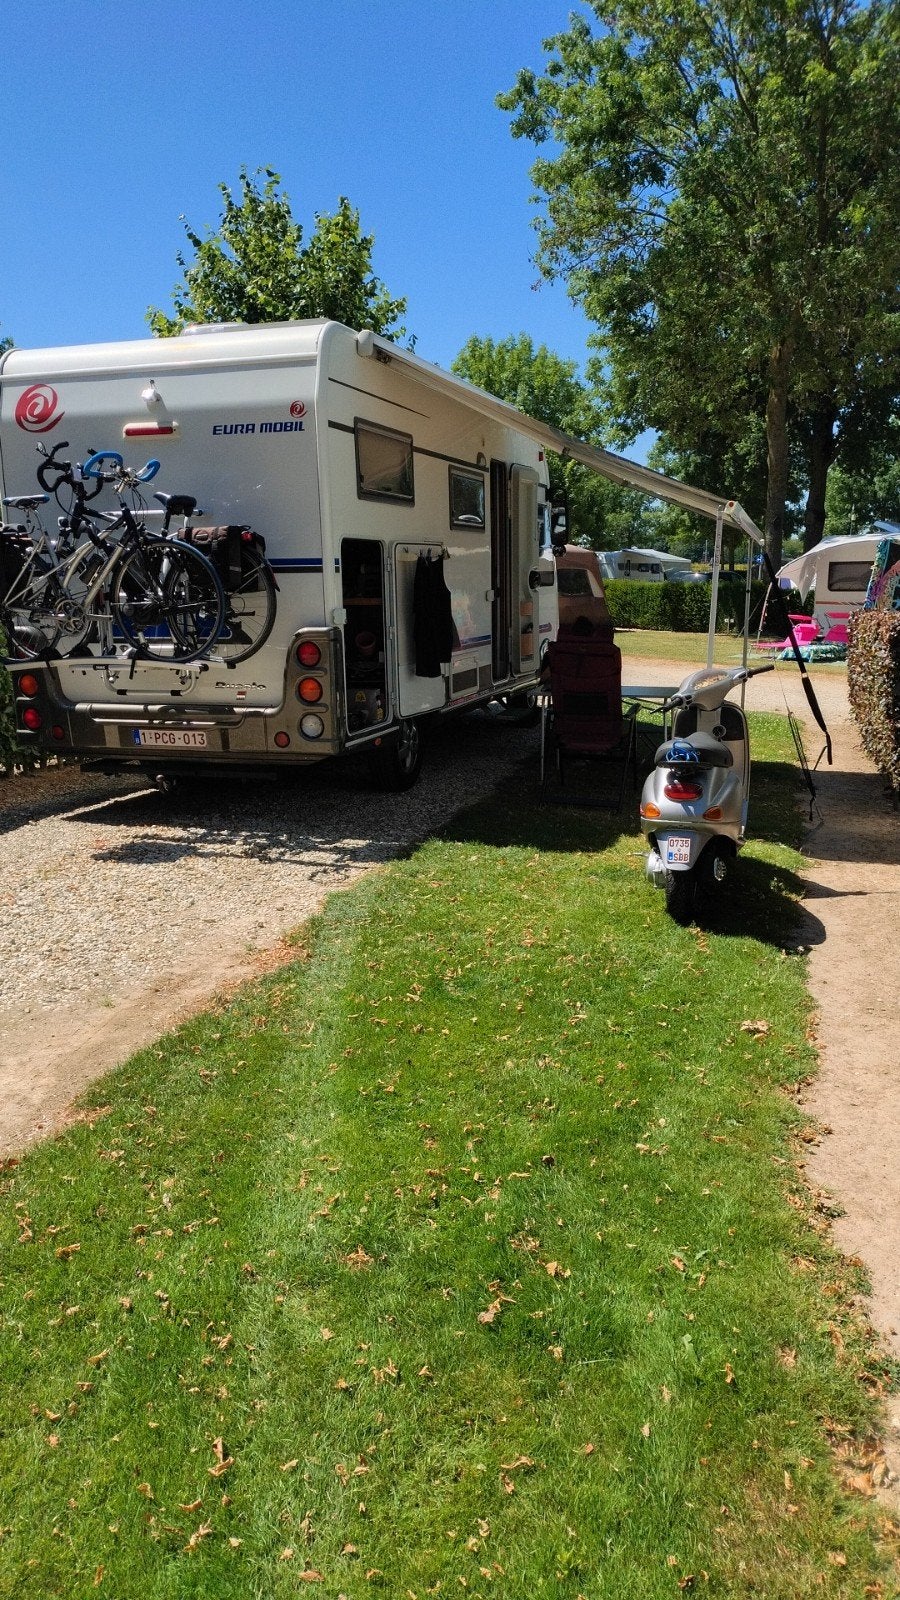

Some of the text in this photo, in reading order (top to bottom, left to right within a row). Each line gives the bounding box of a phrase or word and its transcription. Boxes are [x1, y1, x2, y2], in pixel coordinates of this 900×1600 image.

[213, 421, 305, 435] EURA MOBIL
[141, 732, 206, 745] 1-PCG-013
[670, 839, 689, 847] 0735
